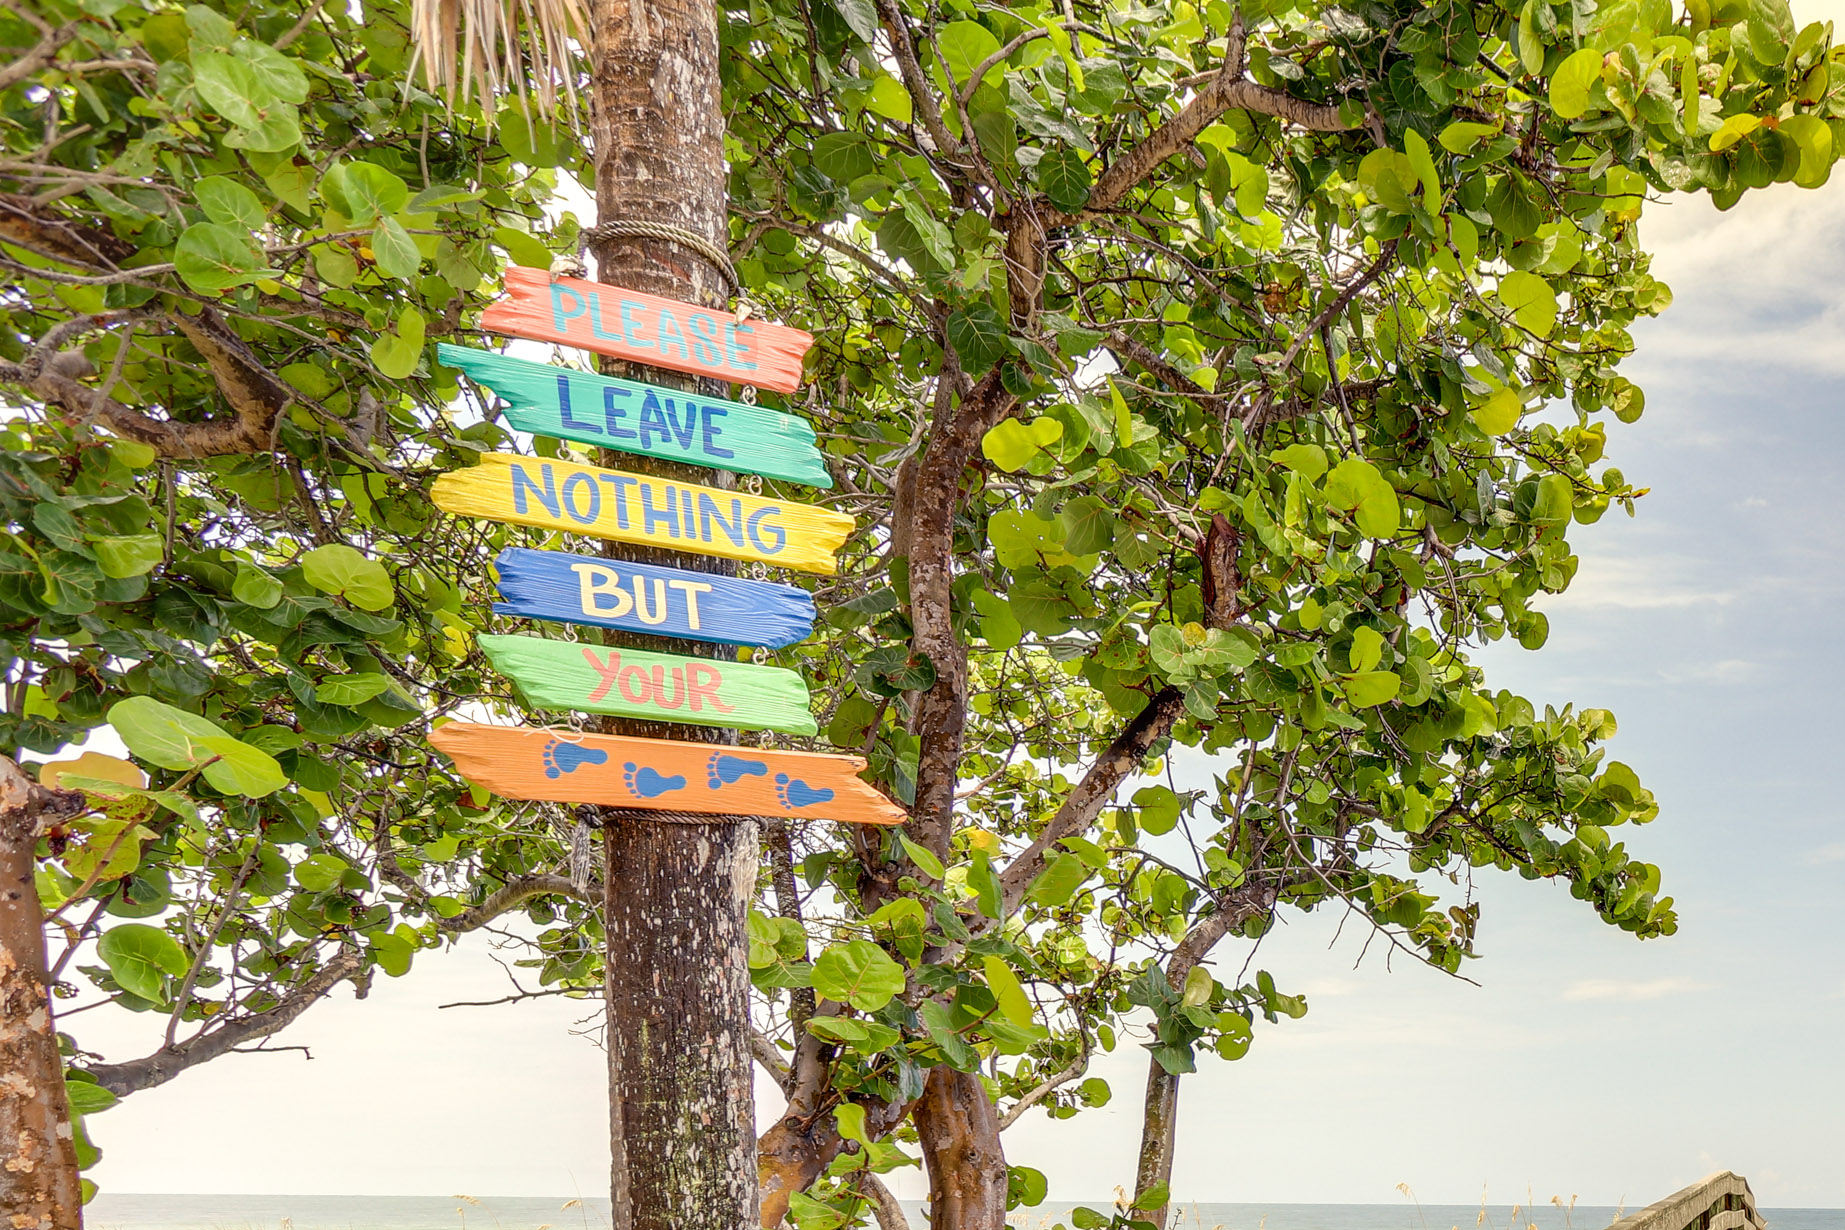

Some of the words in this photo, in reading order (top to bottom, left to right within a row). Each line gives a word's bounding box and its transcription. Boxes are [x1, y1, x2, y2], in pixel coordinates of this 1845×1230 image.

[549, 283, 758, 370] PLEASE
[556, 374, 735, 459] LEAVE
[509, 463, 786, 555] NOTHING
[570, 563, 713, 630] BUT
[581, 647, 736, 713] YOUR
